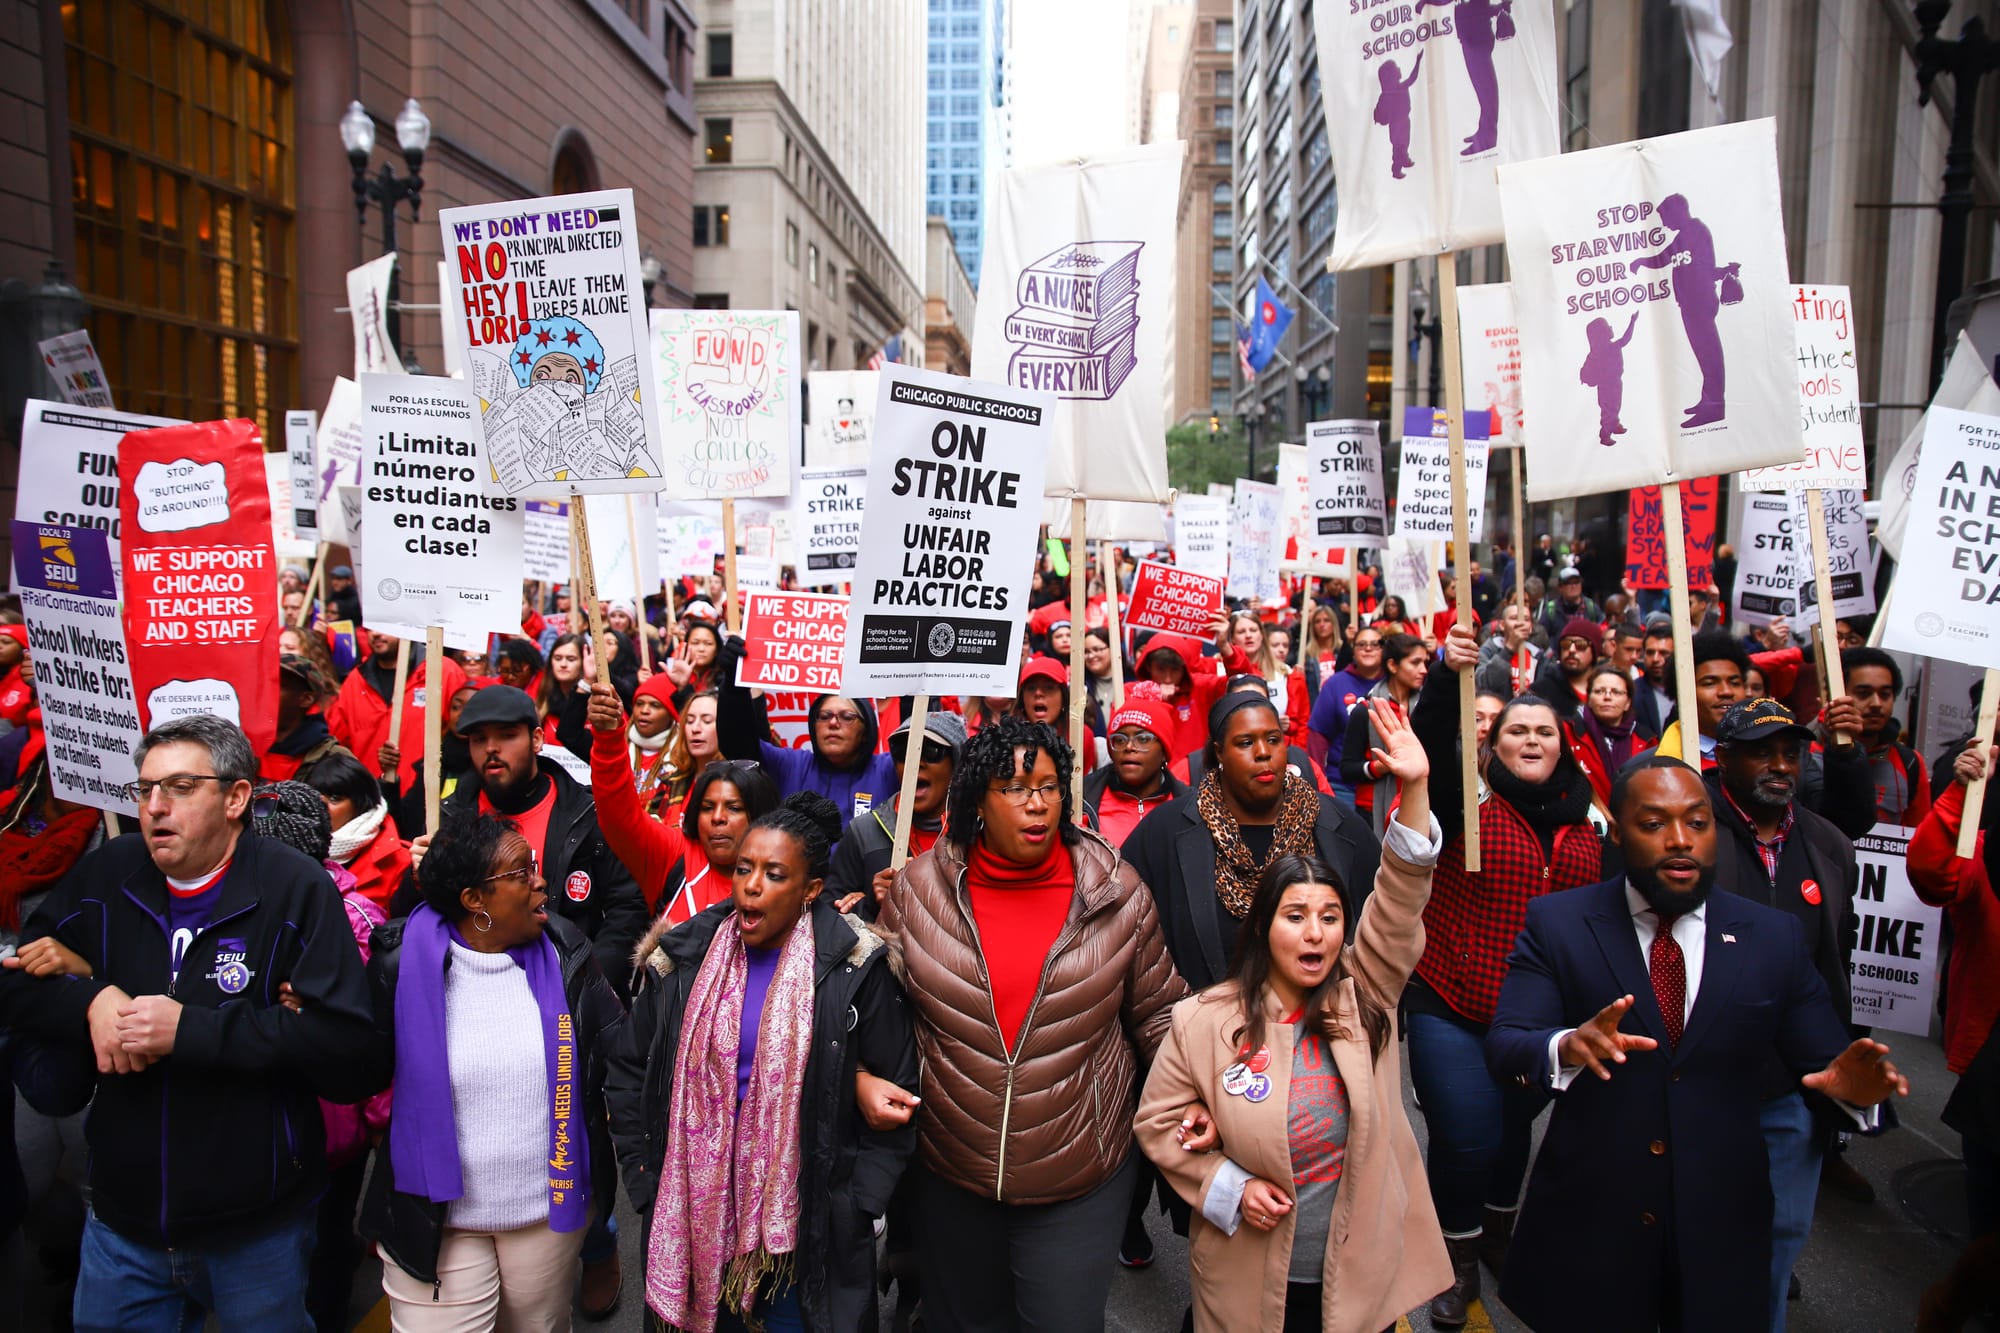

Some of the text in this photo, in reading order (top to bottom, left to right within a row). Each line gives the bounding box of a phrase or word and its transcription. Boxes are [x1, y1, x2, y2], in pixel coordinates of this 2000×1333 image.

[1370, 5, 1412, 33] OUR
[1362, 16, 1453, 61] SCHOOLS
[453, 208, 598, 241] WE DON'T NEED
[1596, 201, 1654, 229] STOP
[457, 230, 623, 284] NO PRINCIPAL DIRECTED
[1551, 226, 1666, 264] STARVING
[510, 259, 546, 278] TIME
[1670, 249, 1693, 268] CPS
[530, 273, 625, 299] LEAVE THEM
[1576, 262, 1627, 288] OUR
[533, 294, 629, 318] PREPS ALONE
[1024, 274, 1094, 315] A NURSE
[1566, 278, 1671, 315] SCHOOLS
[1010, 322, 1087, 350] IN EVERY SCHOOL
[697, 335, 765, 366] FUND
[1797, 343, 1840, 370] the
[1018, 359, 1102, 392] EVERY DAY
[389, 395, 409, 404] POR
[411, 396, 428, 405] LAS
[528, 392, 557, 421] GRADING
[536, 386, 564, 412] REACH
[687, 382, 764, 416] CLASSROOMS
[894, 385, 1039, 424] CHICAGO PUBLIC SCHOOLS
[371, 404, 471, 420] NUESTROS ALUMNOS
[709, 416, 744, 439] NOT
[834, 429, 867, 444] School
[1958, 422, 1983, 436] FOR
[567, 434, 592, 461] ASPEN
[694, 440, 768, 462] CONDOS
[931, 419, 987, 464] ON
[1336, 440, 1363, 456] ON
[374, 458, 476, 484] número
[1319, 457, 1376, 474] STRIKE
[1404, 451, 1450, 468] We do
[167, 467, 195, 478] STOP
[688, 463, 769, 490] CTU STRONG
[890, 457, 1021, 510] STRIKE
[1417, 468, 1438, 483] for
[1945, 459, 1970, 485] A
[149, 480, 216, 498] "BUTCHING"
[367, 485, 518, 513] estudiantes
[822, 484, 848, 498] ON
[1337, 485, 1368, 497] FAIR
[1938, 485, 1978, 514] IN
[144, 495, 225, 516] US AROUND!!!!
[807, 497, 865, 514] STRIKE
[927, 506, 972, 522] against
[1315, 498, 1384, 511] CONTRACT
[1755, 501, 1786, 511] CHICAGO
[39, 528, 72, 539] LOCAL 73
[393, 512, 491, 535] en cada
[813, 522, 861, 535] BETTER
[1181, 519, 1219, 528] SMALLER
[405, 534, 477, 558] clase!
[902, 523, 991, 556] UNFAIR
[1186, 532, 1215, 540] CLASS
[44, 564, 78, 582] SEIU
[133, 550, 267, 572] WE SUPPORT
[902, 551, 984, 582] LABOR
[152, 573, 245, 595] CHICAGO
[1144, 565, 1220, 595] WE SUPPORT
[22, 589, 117, 618] #FairContractNow
[404, 588, 437, 596] TEACHERS
[459, 591, 483, 601] Local
[484, 592, 490, 601] 1
[873, 579, 1010, 611] PRACTICES
[1153, 584, 1209, 607] CHICAGO
[146, 595, 254, 619] TEACHERS
[757, 598, 785, 617] WE
[1145, 597, 1210, 622] TEACHERS
[145, 619, 258, 641] AND STAFF
[773, 619, 847, 642] CHICAG
[866, 628, 907, 638] Fighting for the
[1136, 610, 1206, 636] AND STAFF
[1948, 625, 1991, 640] TEACHERS
[27, 617, 125, 665] School Workers
[865, 635, 998, 648] schools Chicago's TEACHERS
[865, 643, 909, 653] students deserve
[35, 656, 133, 702] on Strike for:
[758, 662, 842, 687] AND STA
[870, 671, 991, 681] American Federation of Teachers Local AFL-CIO
[153, 695, 167, 704] WE
[168, 695, 202, 704] DESERVE
[211, 694, 231, 703] FAIR
[170, 706, 213, 716] CONTRACT
[45, 691, 139, 732] Clean and safe schools
[50, 719, 131, 755] Justice for students
[54, 742, 102, 770] and families
[57, 765, 104, 795] Dignity and
[215, 952, 246, 963] SEIU
[223, 970, 241, 985] 73
[1857, 962, 1920, 987] SCHOOLS
[1887, 998, 1895, 1012] 1
[558, 1013, 573, 1043] JOBS
[556, 1044, 573, 1082] UNION
[1250, 1080, 1266, 1091] 73
[554, 1083, 572, 1121] NEEDS
[548, 1120, 575, 1172] America
